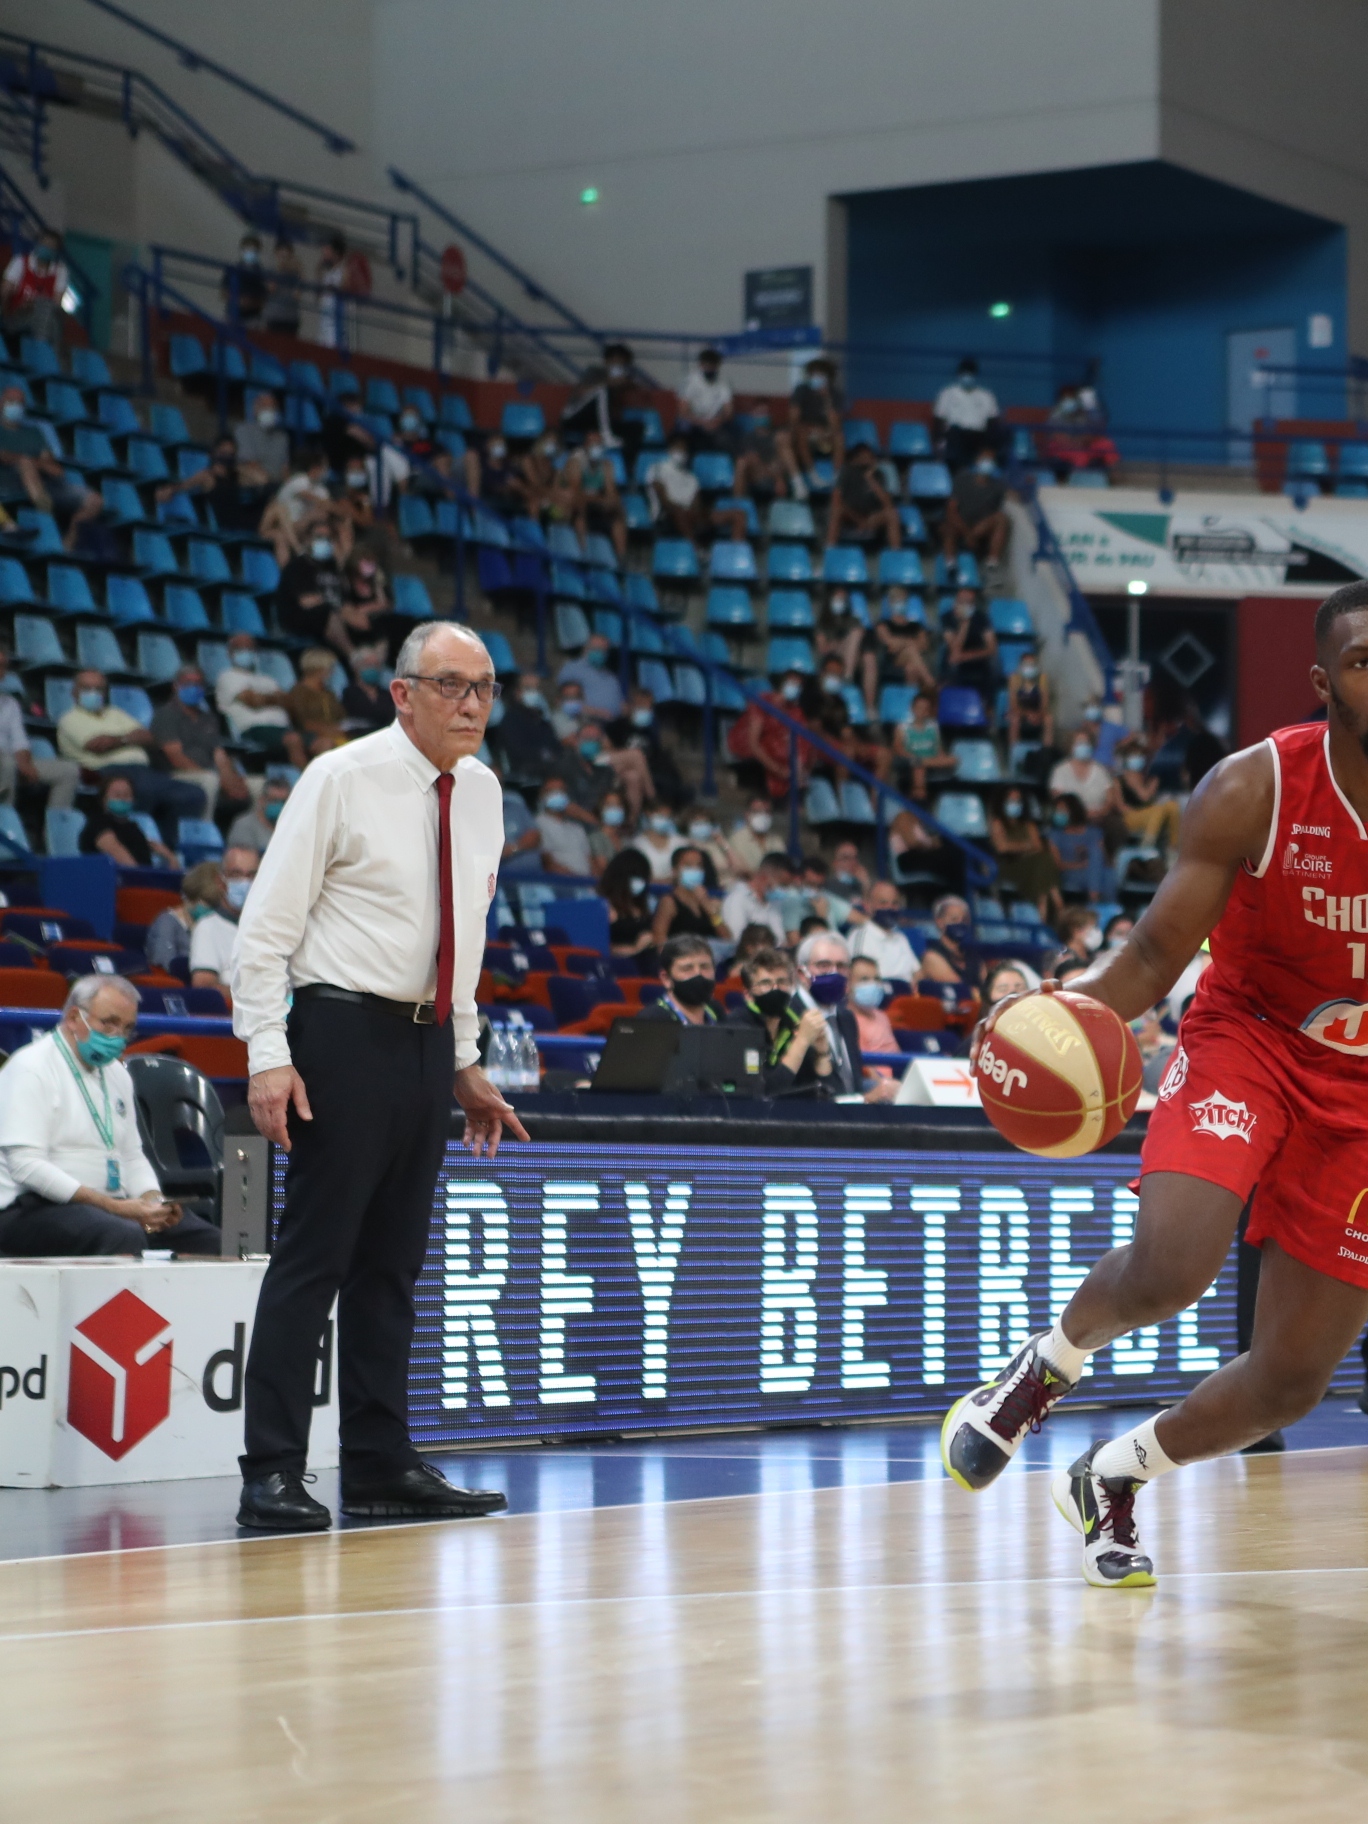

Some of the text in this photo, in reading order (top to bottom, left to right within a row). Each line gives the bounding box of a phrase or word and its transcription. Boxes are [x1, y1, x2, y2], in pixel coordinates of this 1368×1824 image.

[1291, 823, 1331, 838] SPALDING
[1293, 858, 1333, 872] LOIRE
[977, 1041, 1028, 1097] Jeep
[441, 1181, 693, 1409] REY
